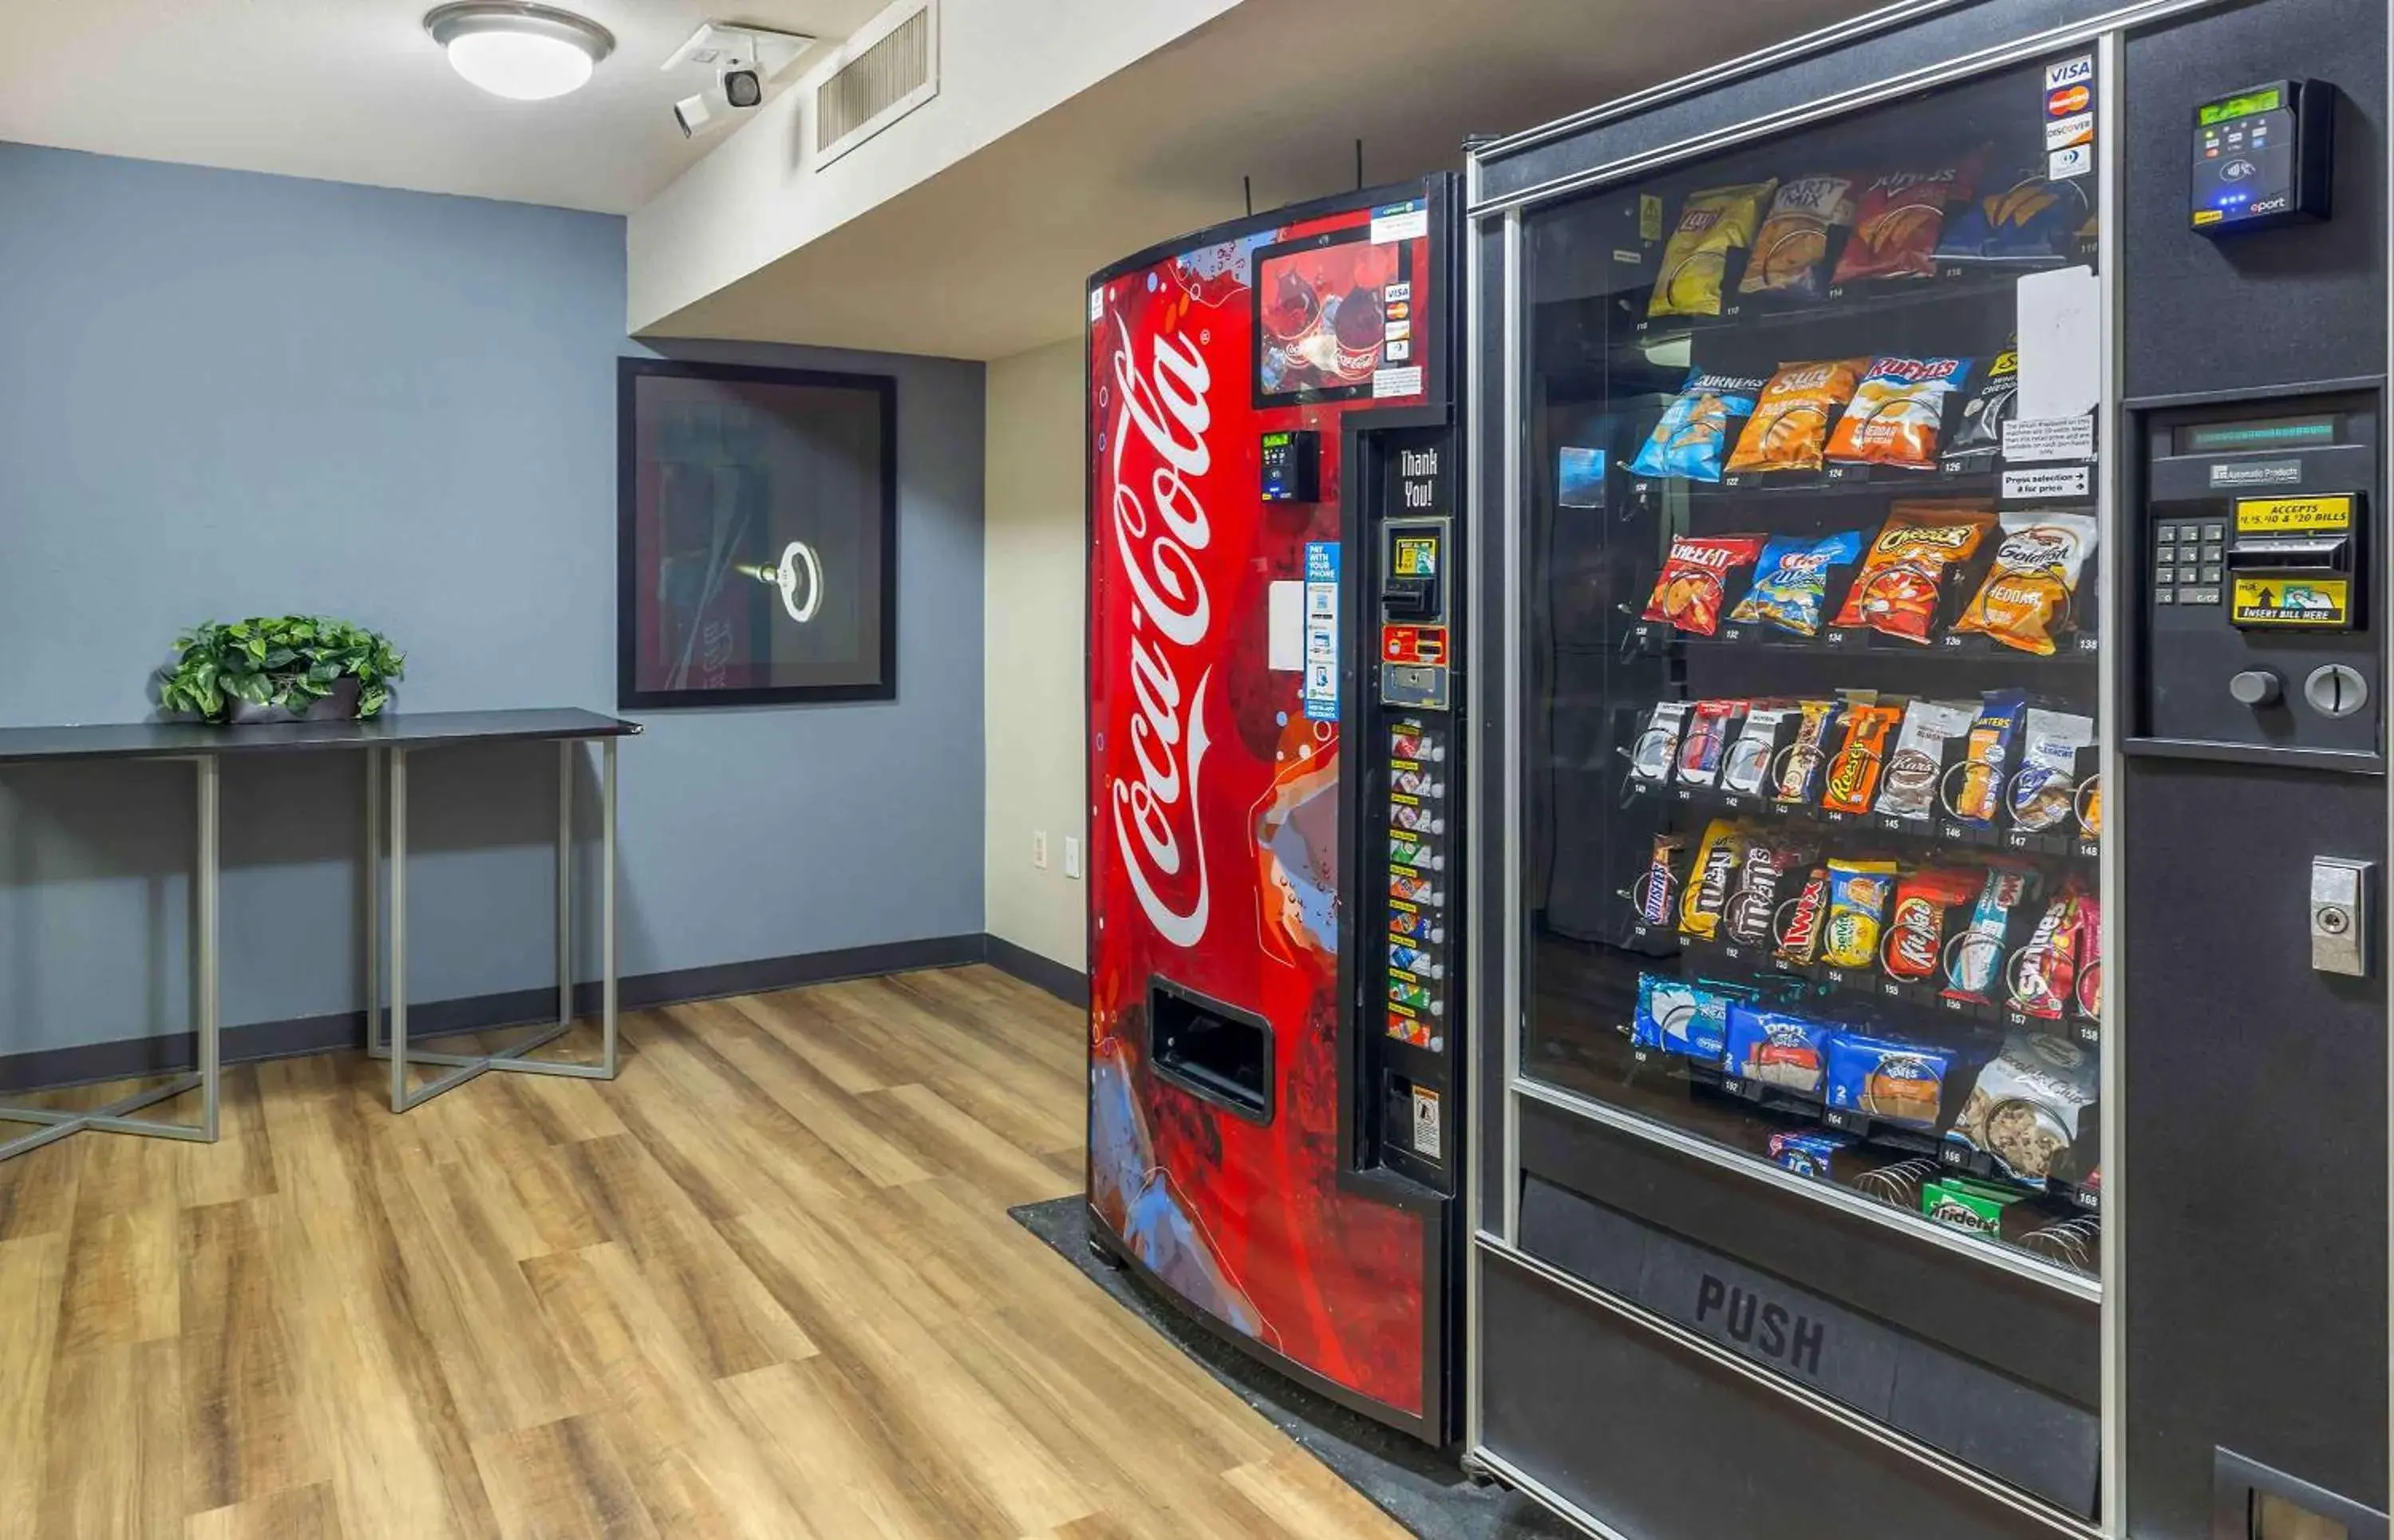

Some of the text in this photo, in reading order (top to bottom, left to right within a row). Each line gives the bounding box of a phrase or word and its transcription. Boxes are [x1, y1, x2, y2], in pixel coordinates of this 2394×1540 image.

[2052, 62, 2089, 82] VISA
[2048, 122, 2090, 137] DISCOVER
[1784, 191, 1824, 209] MIX
[1388, 288, 1408, 298] VISA
[1401, 448, 1437, 476] Thank
[1945, 463, 1961, 472] 126
[2032, 474, 2073, 483] selection
[2228, 467, 2297, 480] Automatic Products
[1405, 480, 1432, 507] You!
[2271, 504, 2317, 515] ACCEPTS
[2315, 512, 2345, 522] BILLS
[1998, 544, 2069, 562] Goldfish
[2243, 607, 2330, 620] INSERT BILL HERE
[1112, 310, 1212, 948] Coca-Cola
[1945, 638, 1961, 646] 136
[2080, 640, 2099, 650] 138
[1829, 812, 1842, 821] 144
[1885, 819, 1899, 829] 145
[1945, 827, 1961, 838] 146
[2011, 835, 2025, 847] 147
[2080, 845, 2098, 856] 148
[1885, 984, 1899, 995] 155
[2011, 1013, 2026, 1025] 157
[2080, 1029, 2098, 1040] 158
[1725, 1052, 1733, 1064] 2
[1836, 1085, 1846, 1098] 2
[1827, 1112, 1842, 1125] 164
[2080, 1192, 2099, 1205] 168
[1929, 1200, 1999, 1230] Trident
[1697, 1273, 1823, 1375] PUSH
